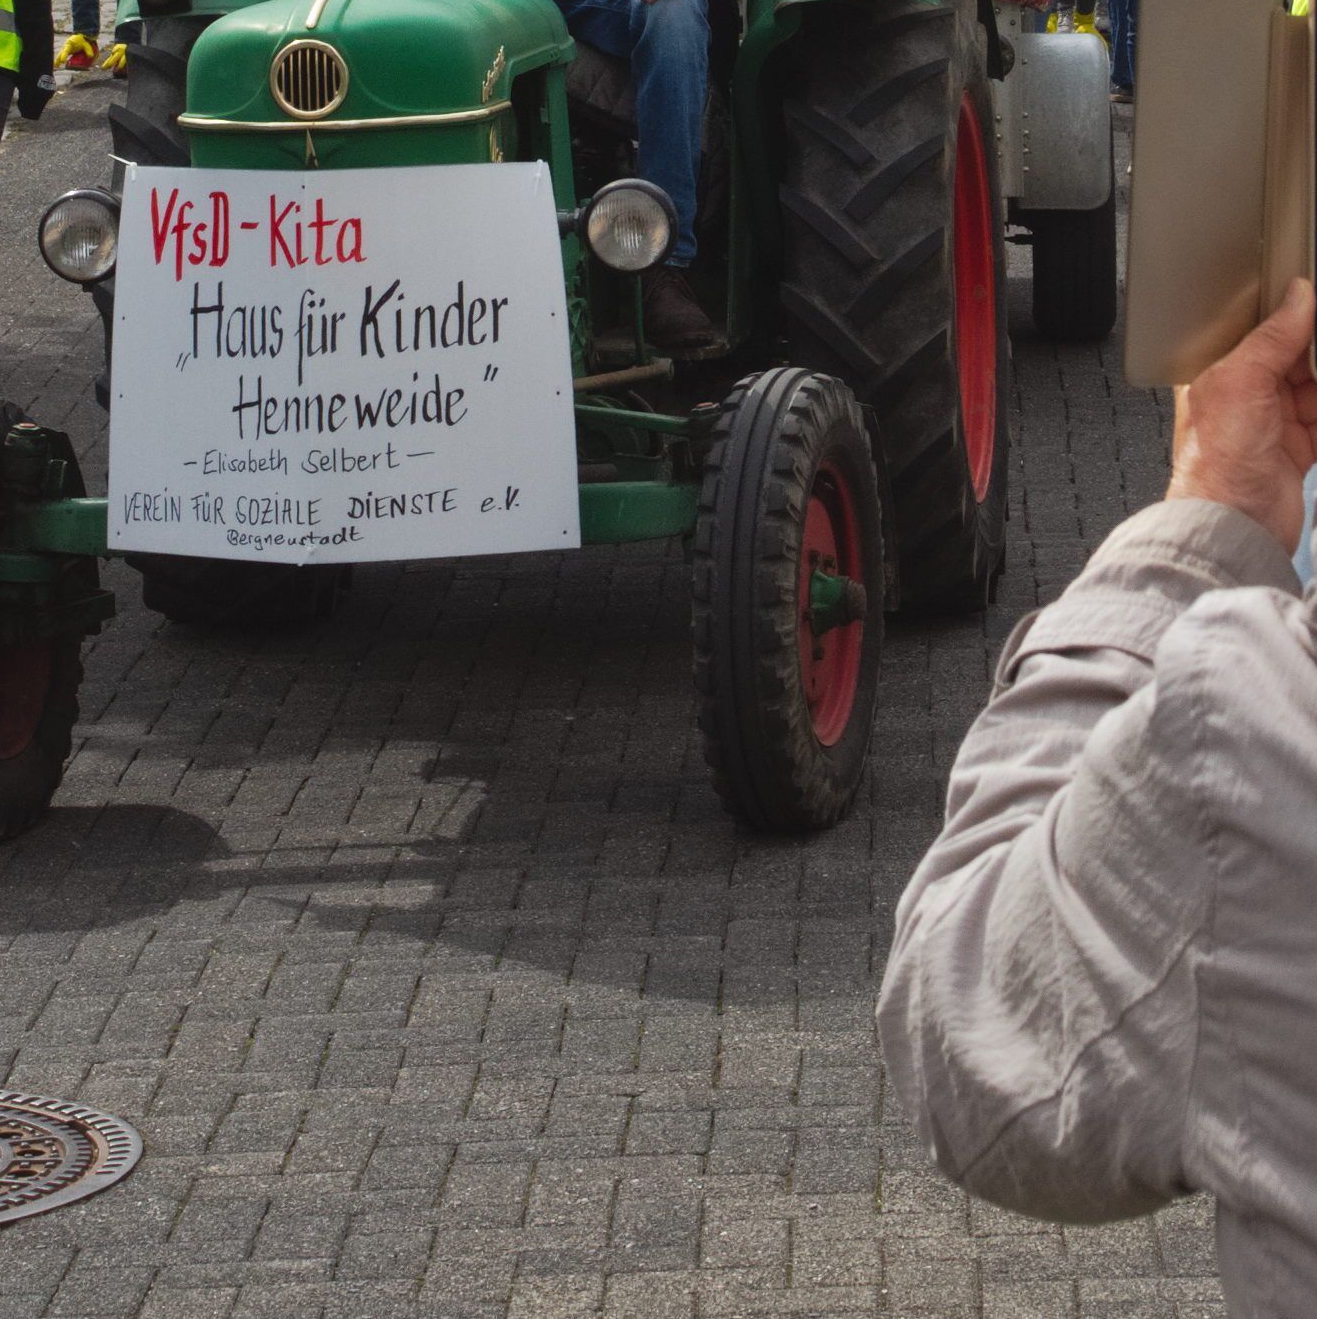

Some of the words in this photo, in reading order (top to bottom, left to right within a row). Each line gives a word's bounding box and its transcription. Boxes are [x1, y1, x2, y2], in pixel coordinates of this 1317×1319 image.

[293, 288, 347, 387] für
[359, 278, 509, 359] Kinder
[226, 526, 365, 551] Bergneustadt
